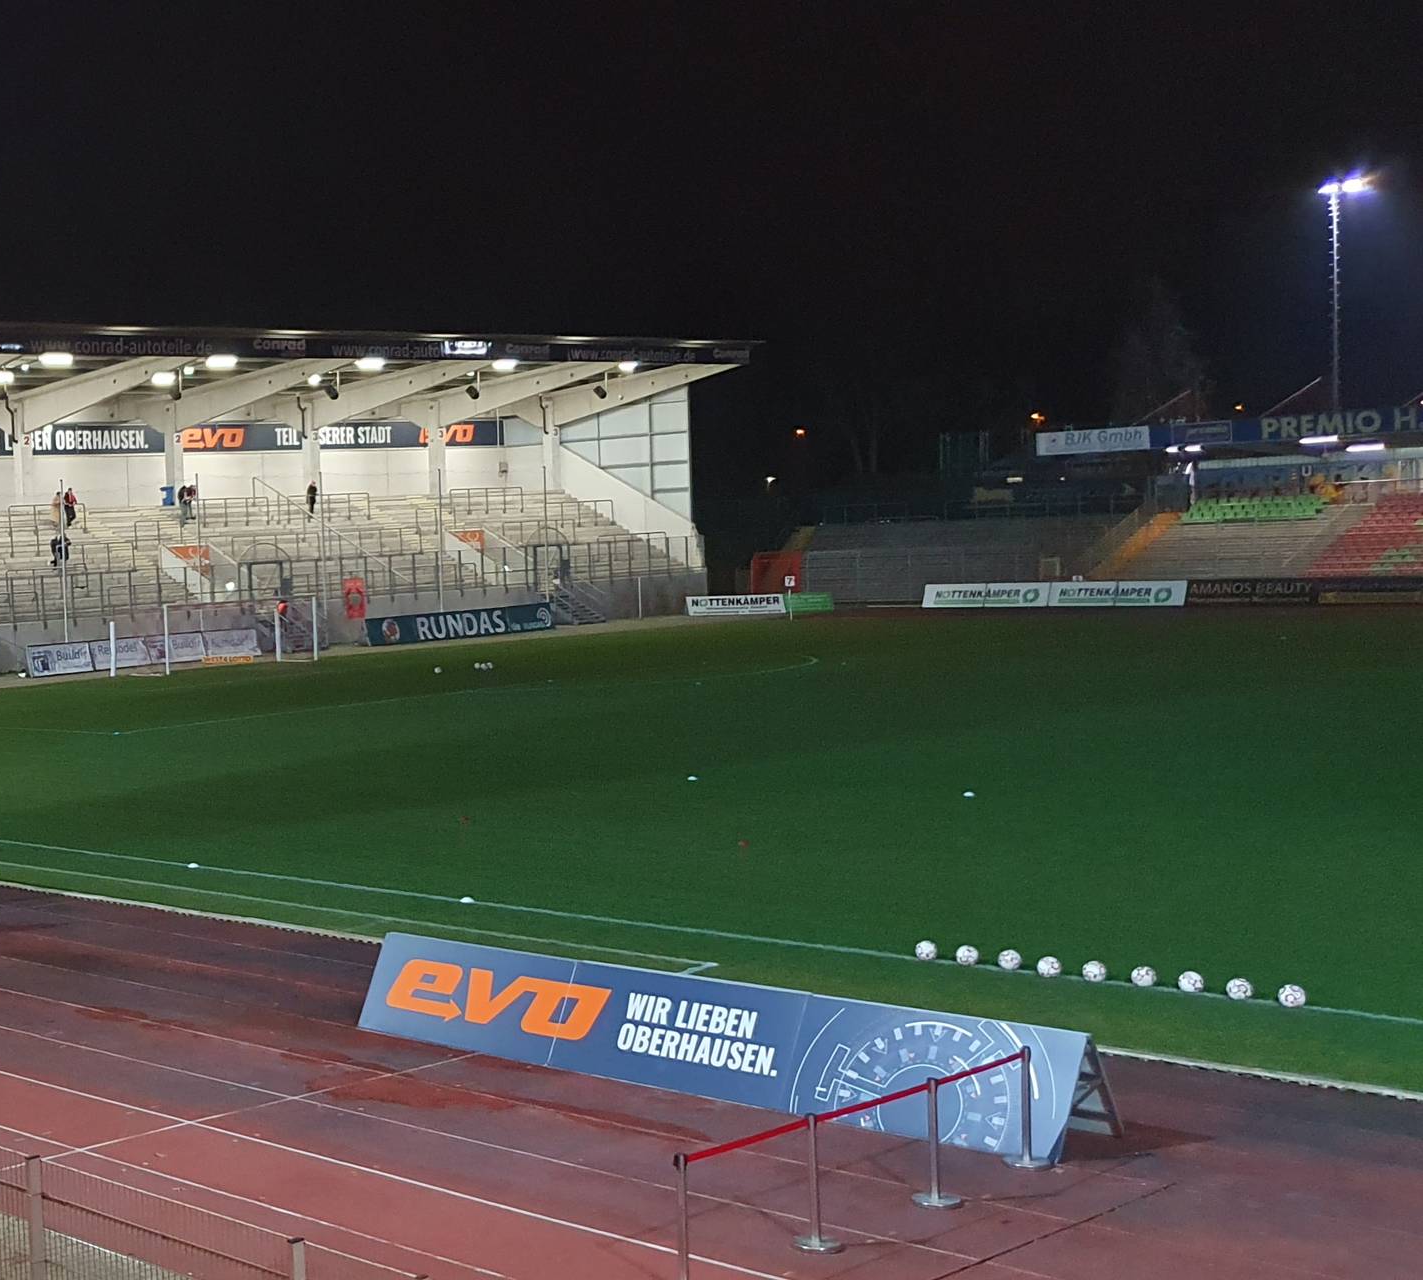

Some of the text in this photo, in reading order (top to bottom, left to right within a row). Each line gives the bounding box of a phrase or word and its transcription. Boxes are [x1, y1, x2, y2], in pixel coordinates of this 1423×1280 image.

[253, 339, 306, 350] Conrad
[1261, 408, 1381, 440] PREMIO
[23, 436, 30, 445] 2
[55, 430, 148, 450] OBERHAUSEN.
[182, 428, 245, 449] evo
[275, 427, 299, 446] TEIL
[358, 425, 392, 444] STADT
[786, 577, 793, 585] 7
[1190, 582, 1251, 594] AMANOS
[416, 610, 505, 641] RUNDAS
[386, 958, 613, 1041] evo
[626, 992, 758, 1040] WIR LIEBEN
[617, 1023, 778, 1077] OBERHAUSEN.
